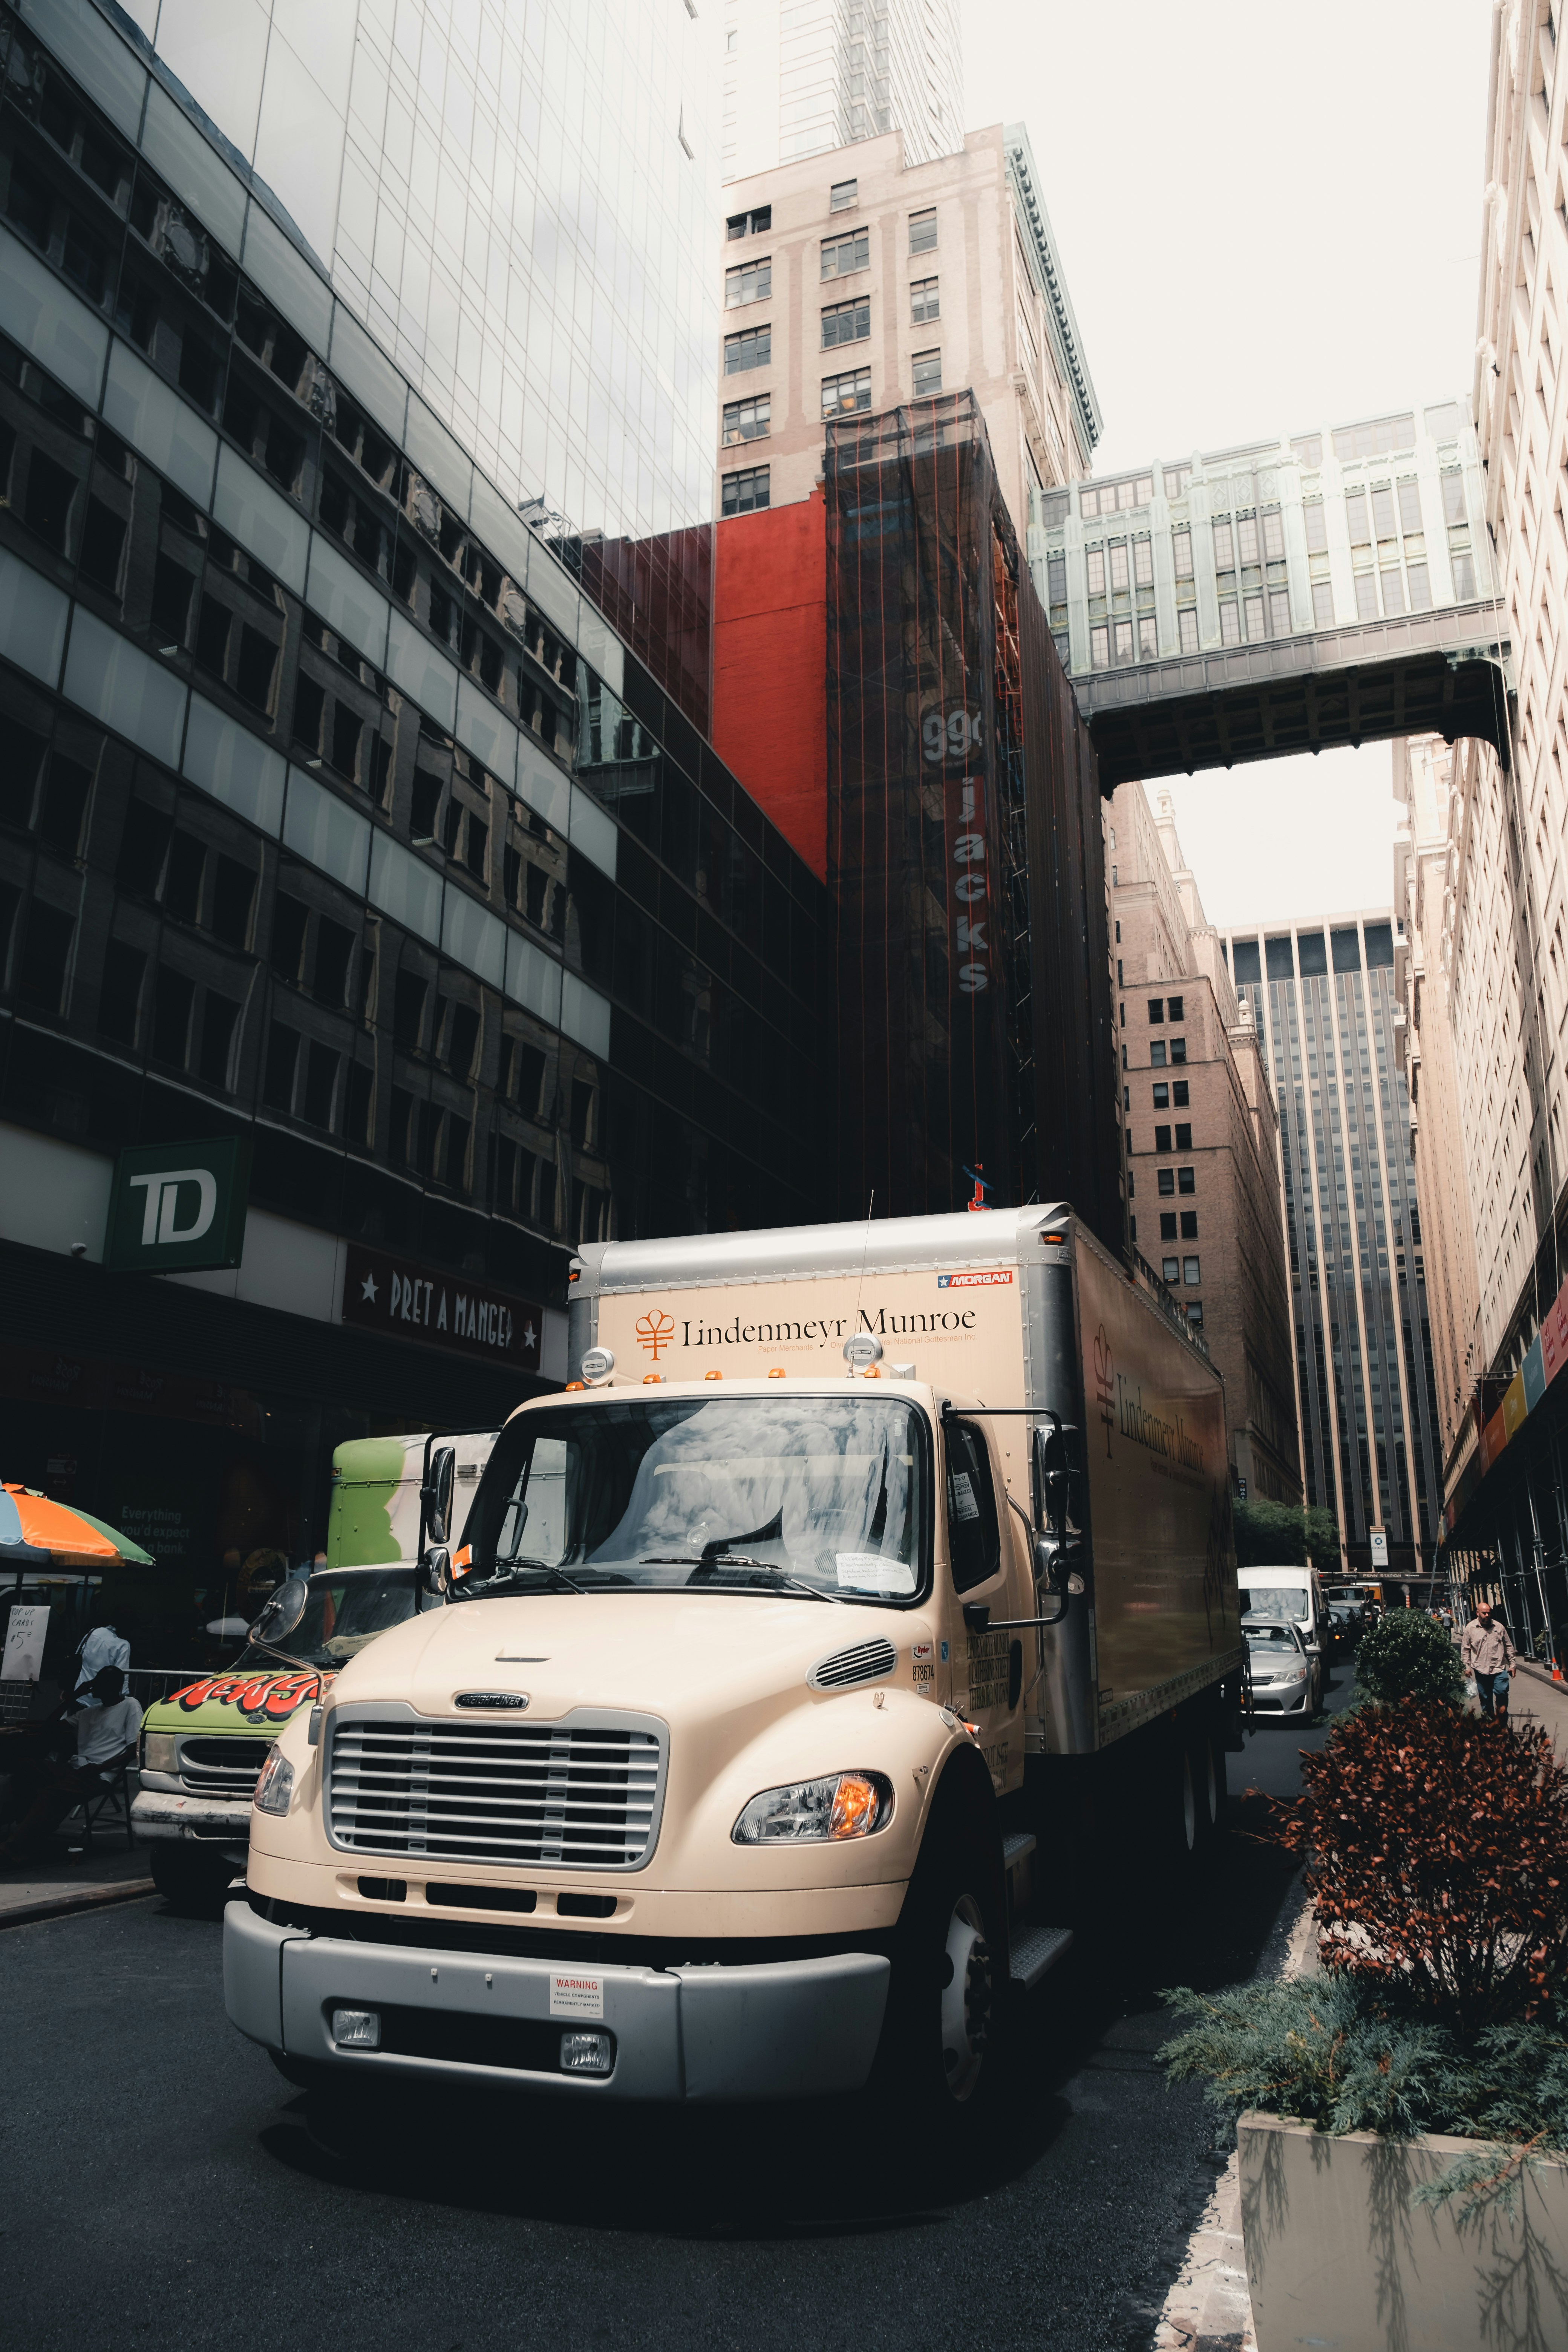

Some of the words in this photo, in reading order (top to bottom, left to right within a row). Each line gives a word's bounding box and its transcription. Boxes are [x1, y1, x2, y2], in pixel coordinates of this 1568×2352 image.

[130, 1169, 217, 1245] TD
[951, 1273, 1009, 1286] MORGAN
[389, 1269, 433, 1326] PRET
[436, 1287, 447, 1331] A
[681, 1317, 847, 1348] Lindenmeyr
[858, 1308, 977, 1334] Munroe
[758, 1345, 777, 1354] Paper
[779, 1344, 813, 1352] Merchants
[894, 1337, 922, 1345] National
[926, 1335, 962, 1344] Gottesman
[1116, 1372, 1174, 1479] Lindenmeyr
[121, 1505, 182, 1524] Everything
[153, 1527, 190, 1540] expect
[147, 1544, 154, 1553] a
[156, 1541, 187, 1554] bank.
[917, 1646, 929, 1655] Ryder
[913, 1664, 934, 1682] 878674
[461, 1695, 521, 1706] FREIGHTLINER
[556, 1978, 597, 1990] WARNING
